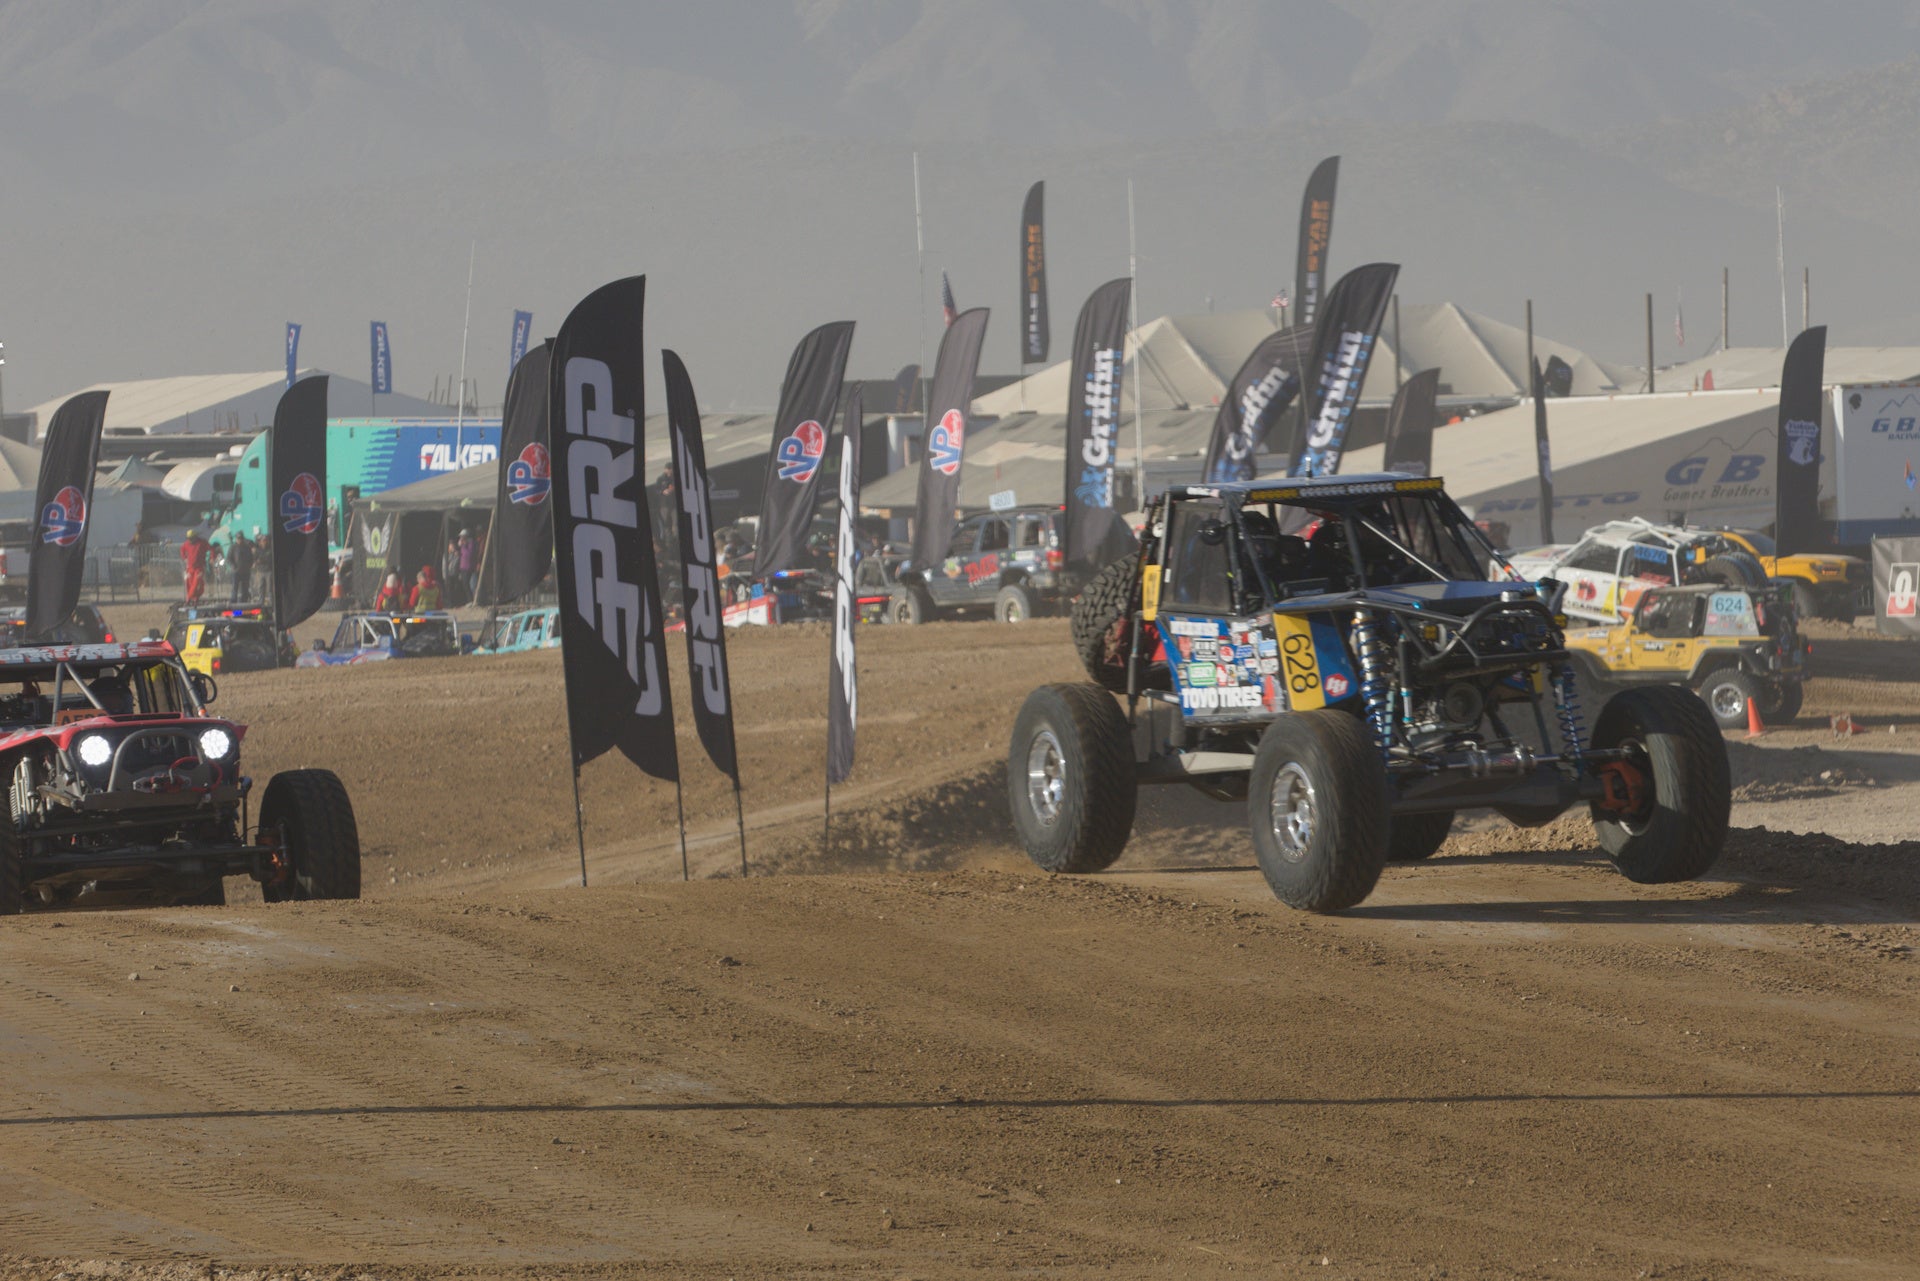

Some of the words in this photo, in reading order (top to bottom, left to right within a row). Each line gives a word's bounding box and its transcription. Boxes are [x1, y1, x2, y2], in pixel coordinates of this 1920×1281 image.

[1082, 348, 1114, 466] Griffin
[1307, 331, 1363, 448] Griffin
[418, 444, 497, 472] FALKEN
[777, 436, 820, 480] VP
[929, 425, 961, 470] VP
[507, 460, 550, 504] VP
[1711, 484, 1771, 498] Brothers
[41, 502, 84, 544] VP
[280, 490, 322, 533] VP
[565, 356, 639, 686] PRP
[1715, 597, 1742, 613] 624
[1283, 633, 1319, 693] 628
[1182, 687, 1218, 708] TOYO
[1219, 685, 1262, 707] TIRES
